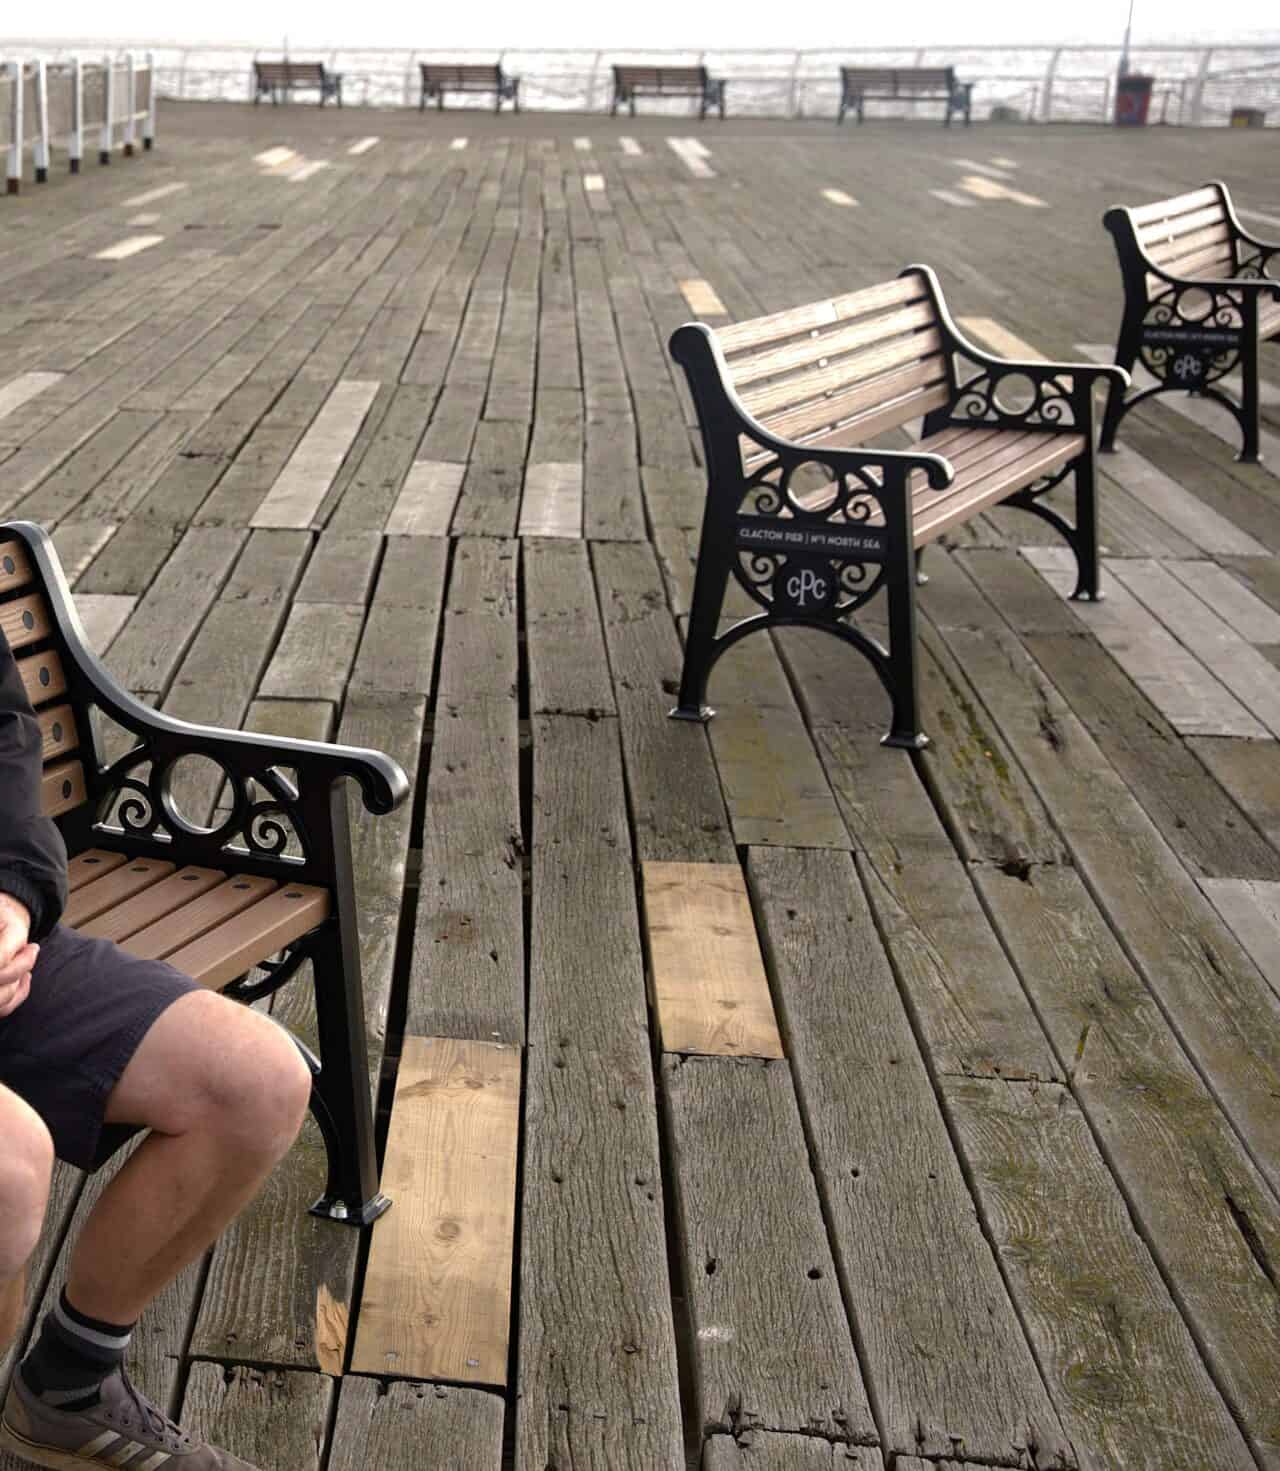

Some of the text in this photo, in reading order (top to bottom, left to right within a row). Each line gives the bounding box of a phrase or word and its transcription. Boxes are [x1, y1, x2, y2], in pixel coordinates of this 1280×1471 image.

[740, 527, 783, 541] CLACTON
[784, 531, 804, 543] PIER
[827, 535, 860, 548] NORTH
[862, 538, 881, 550] SEA
[786, 569, 827, 606] CPC
